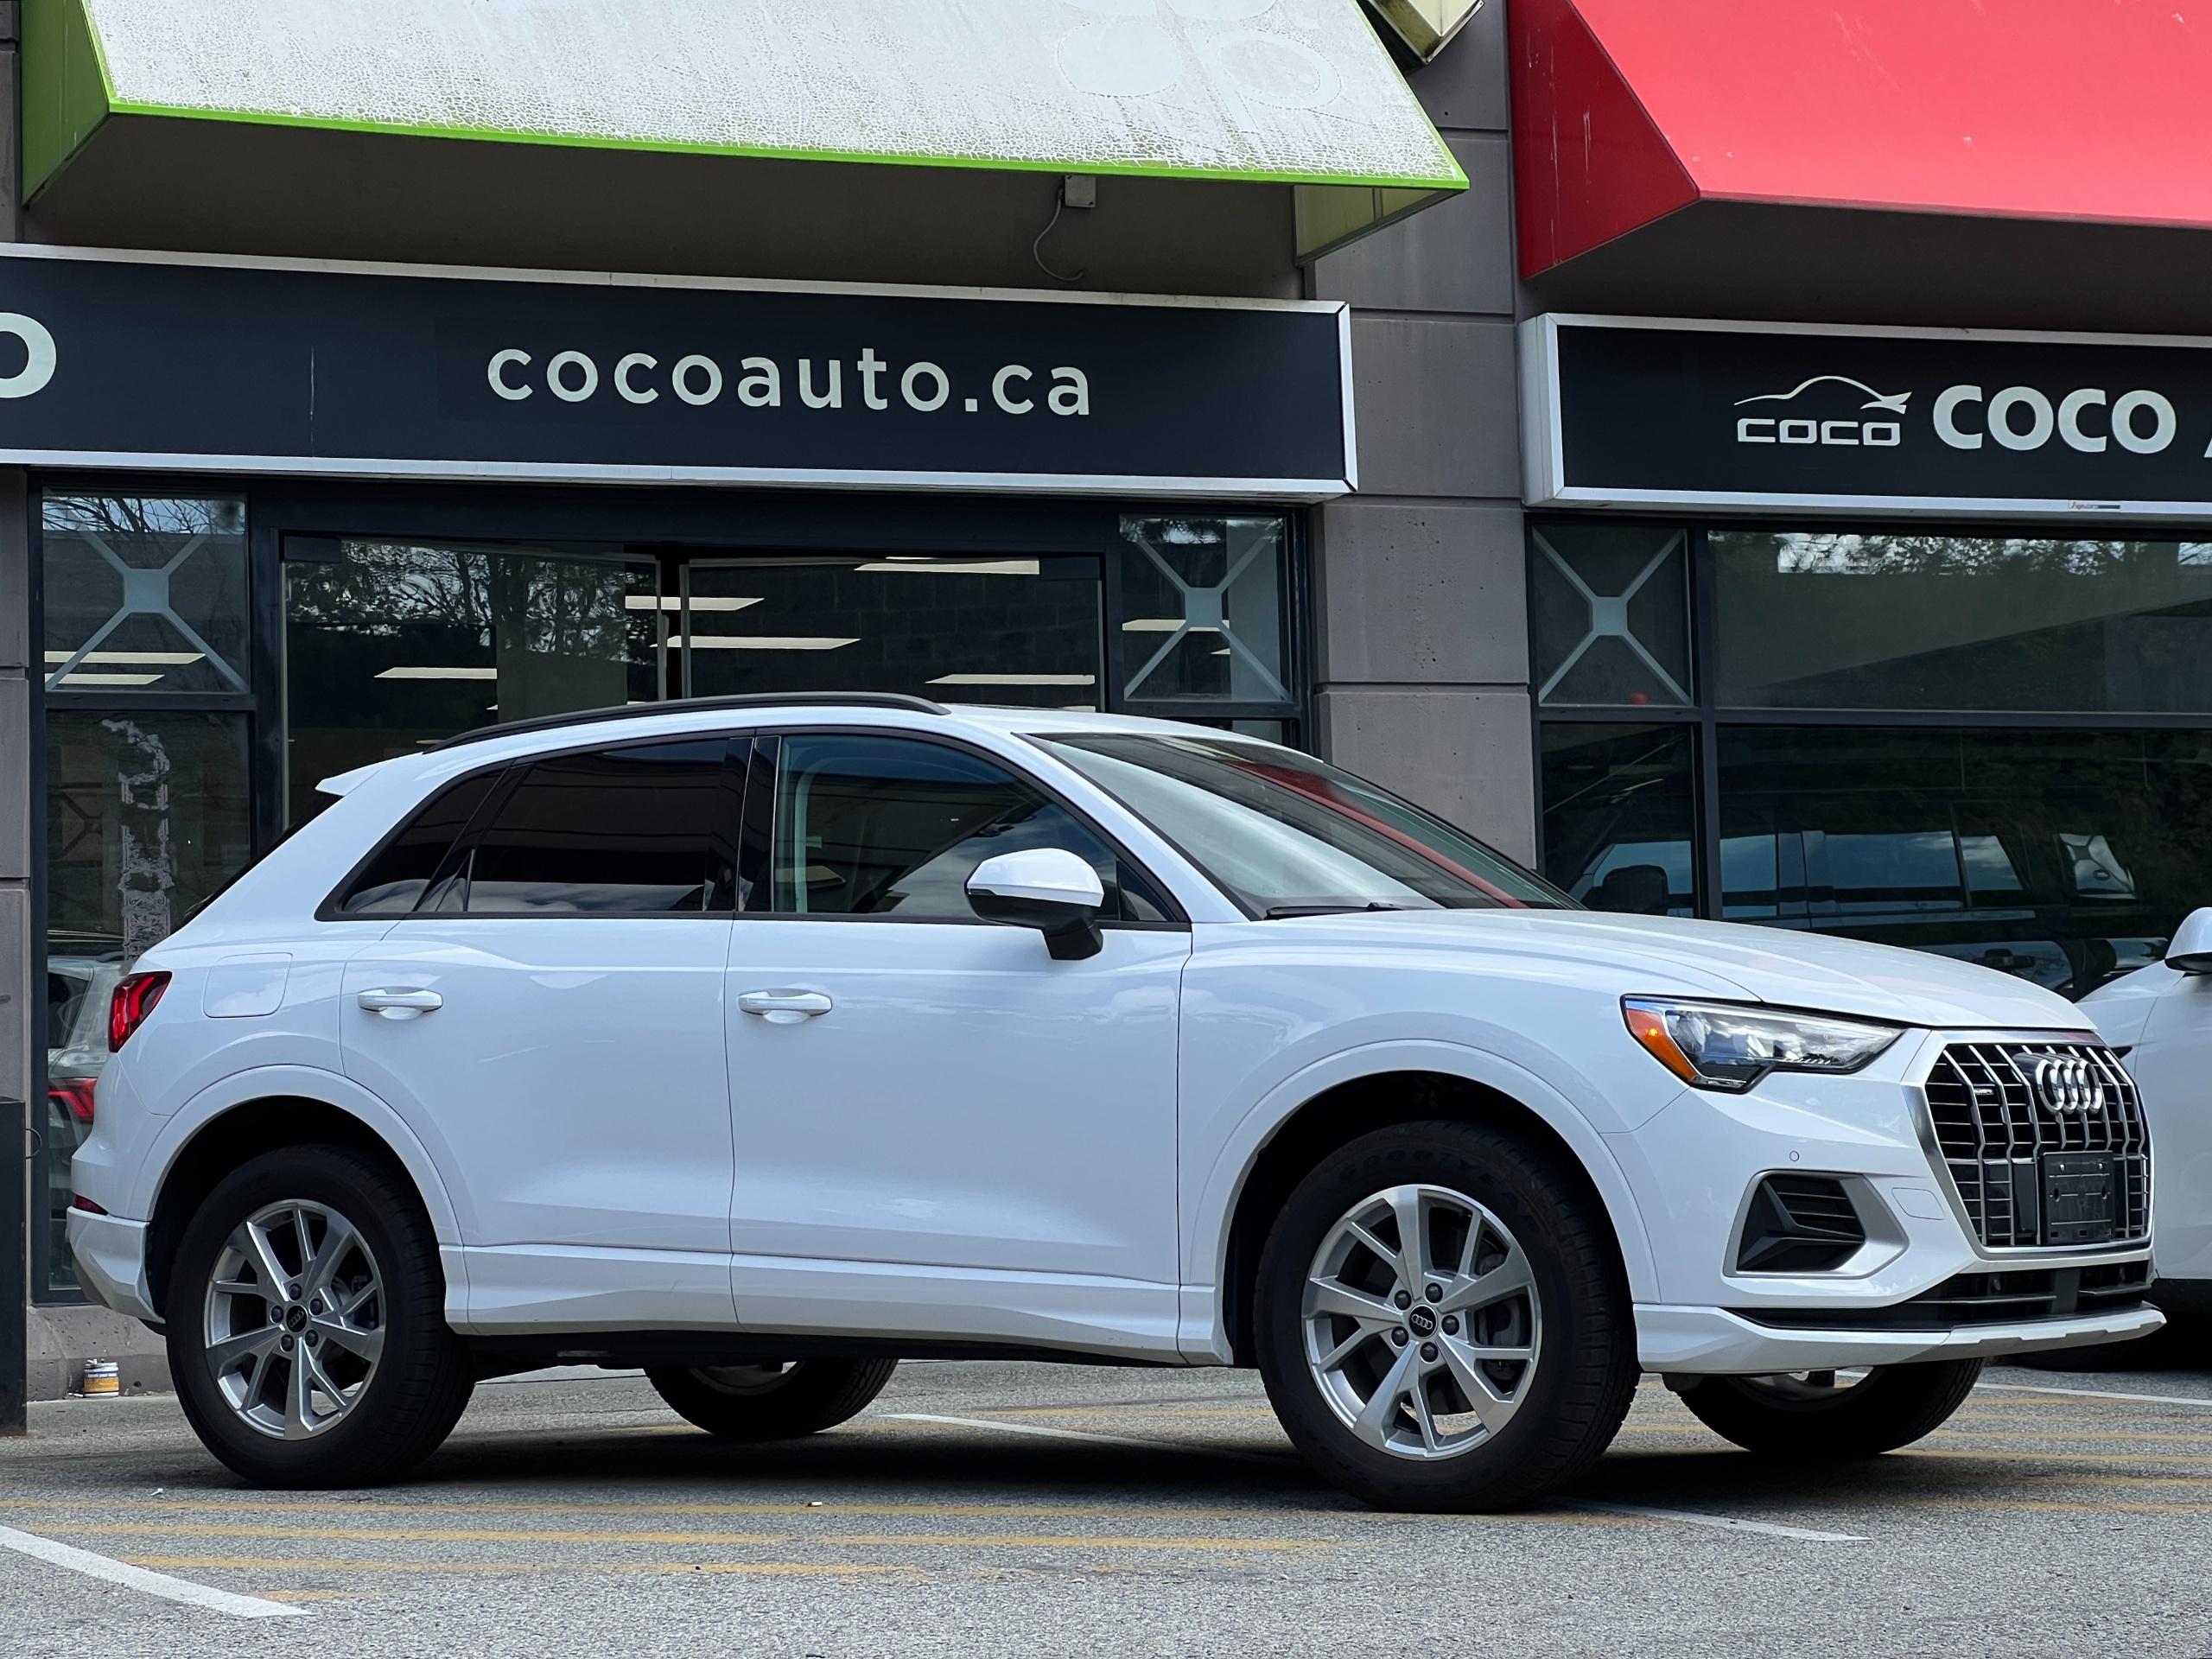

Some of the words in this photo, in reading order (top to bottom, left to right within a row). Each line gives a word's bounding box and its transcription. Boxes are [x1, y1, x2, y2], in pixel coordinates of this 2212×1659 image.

[487, 348, 1090, 416] cocoauto.ca
[1737, 417, 1901, 447] COCO
[1933, 385, 2177, 454] COCO
